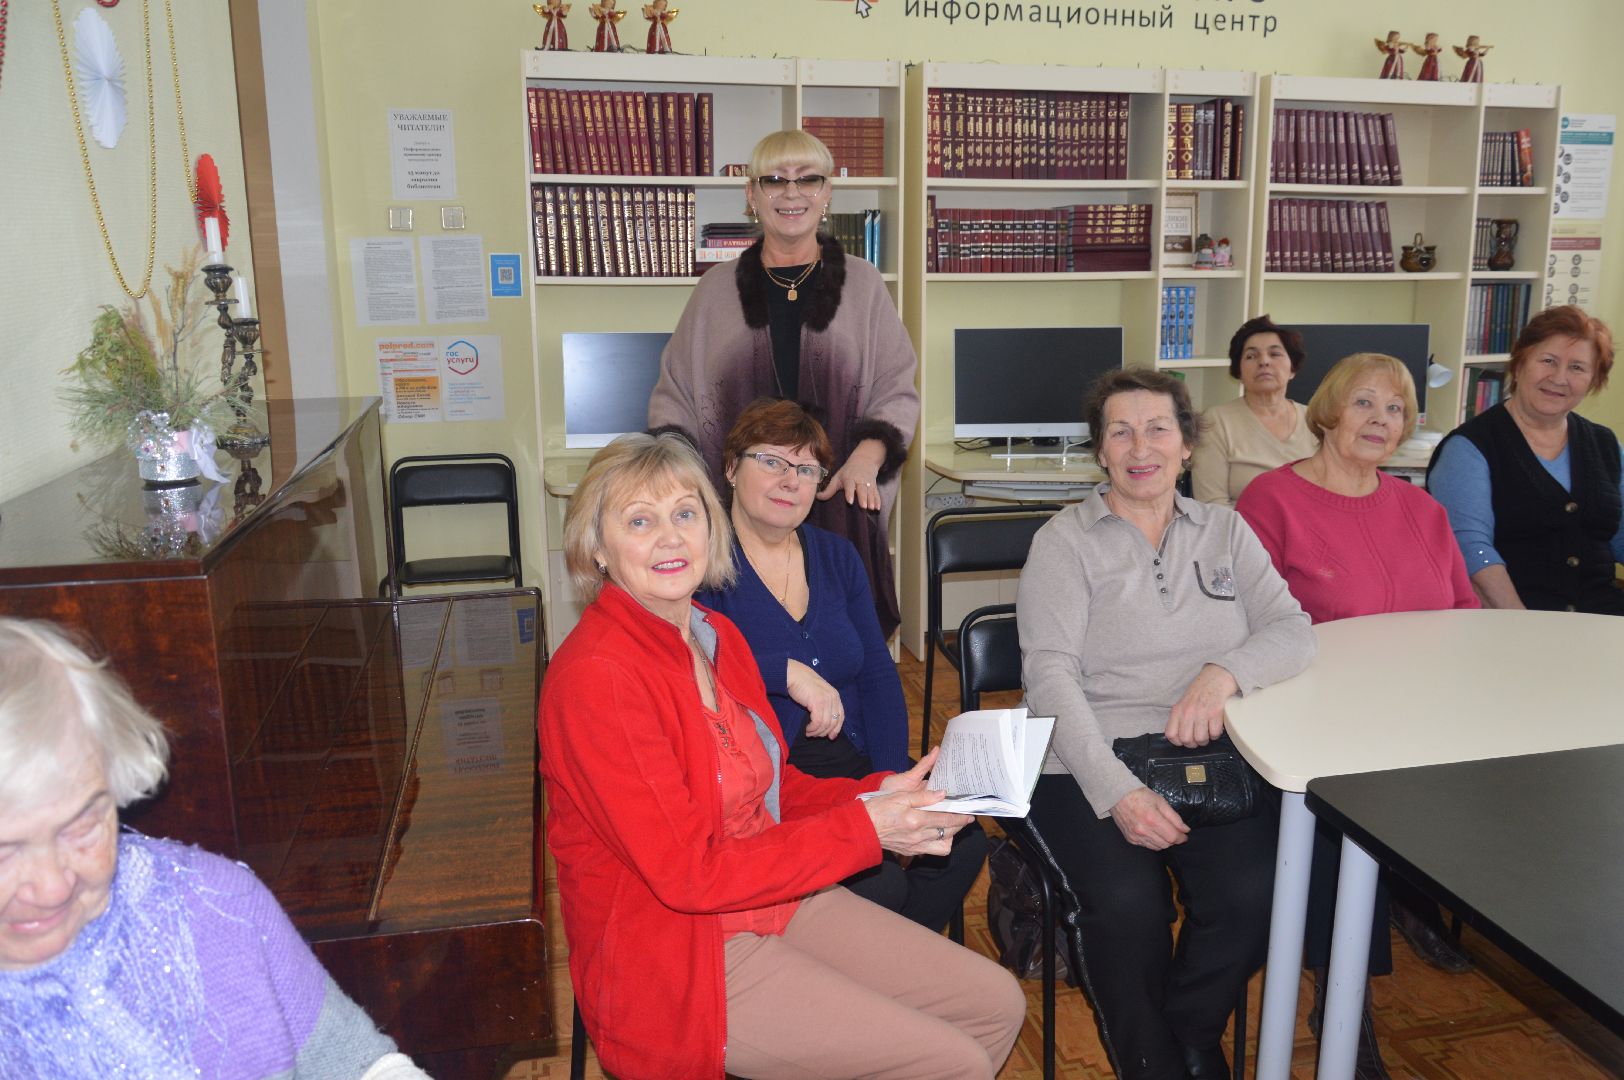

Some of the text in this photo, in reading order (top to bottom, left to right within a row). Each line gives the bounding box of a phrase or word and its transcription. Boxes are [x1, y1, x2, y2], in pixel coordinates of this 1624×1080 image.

[904, 0, 1277, 37] информационный центр
[393, 113, 448, 121] УВАЖАЕМЫЕ
[397, 124, 445, 132] ЧИТАТЕЛИ!
